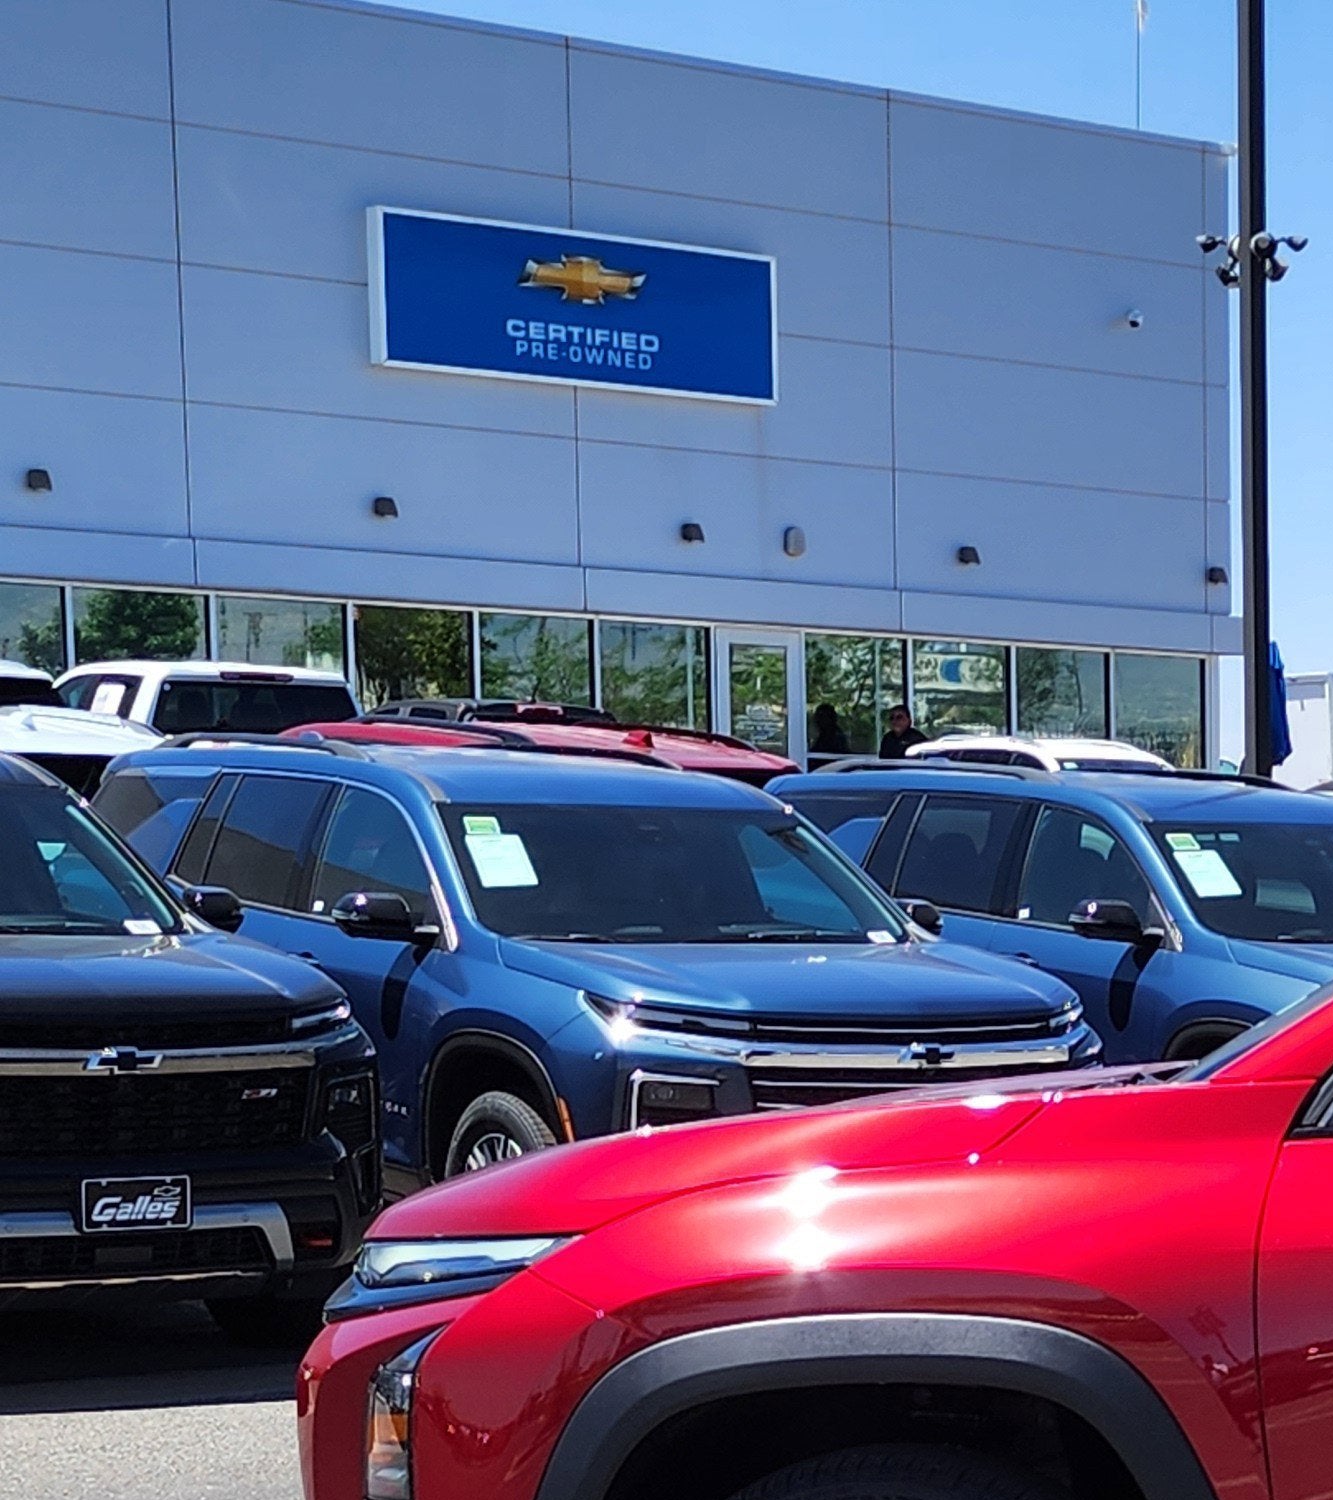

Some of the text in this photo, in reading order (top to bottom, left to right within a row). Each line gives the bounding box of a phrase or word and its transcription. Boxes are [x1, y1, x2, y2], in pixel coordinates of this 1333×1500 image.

[505, 318, 660, 353] CERTIFIED
[515, 340, 653, 371] PRE-OWNED
[91, 1195, 180, 1222] Galles
